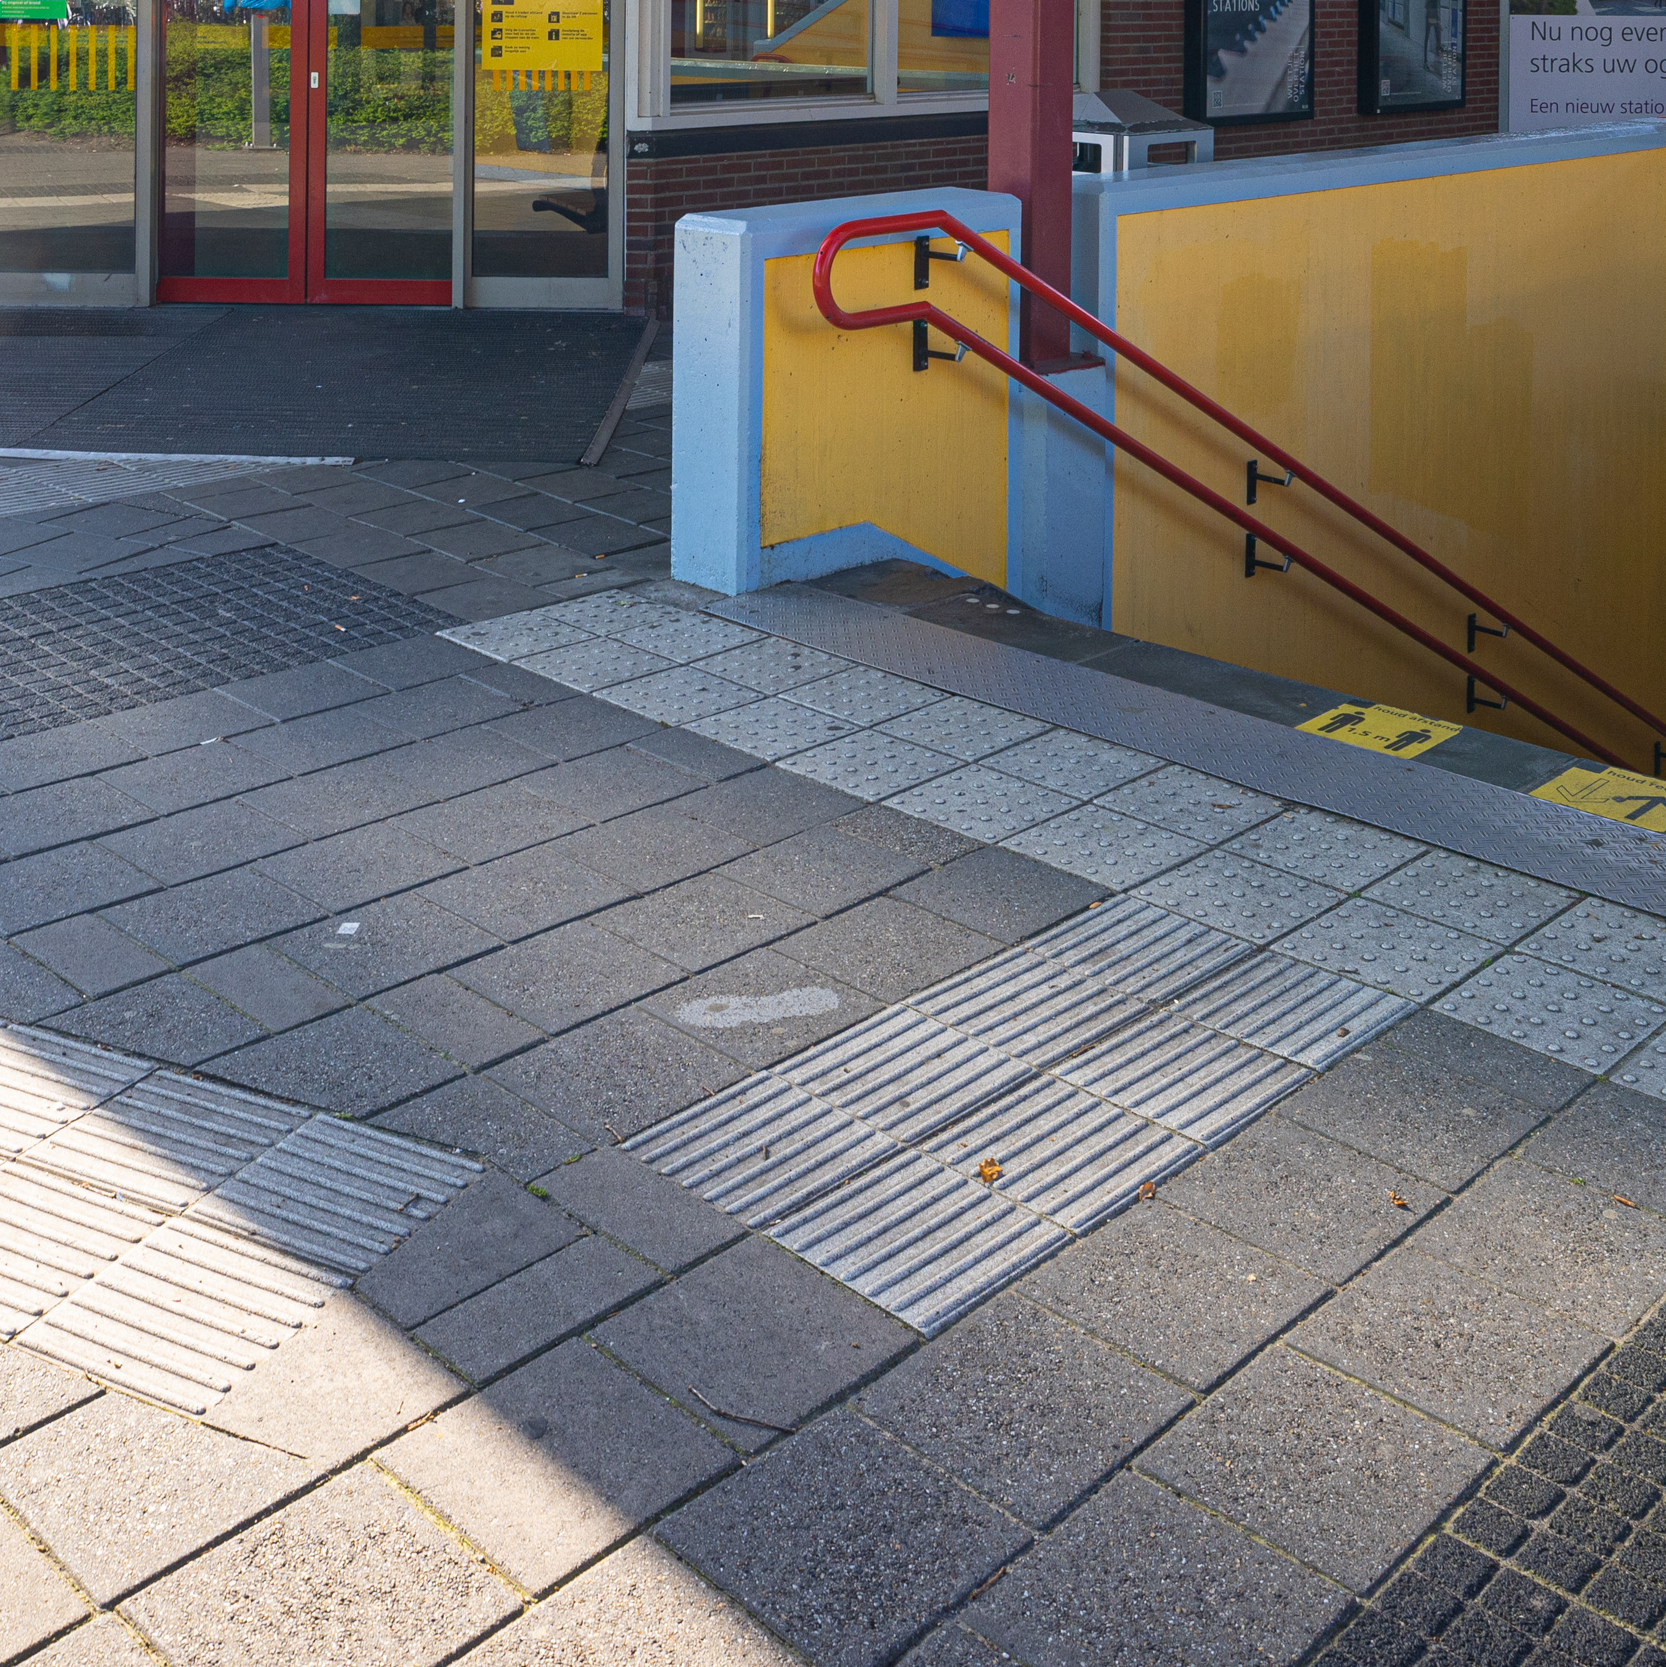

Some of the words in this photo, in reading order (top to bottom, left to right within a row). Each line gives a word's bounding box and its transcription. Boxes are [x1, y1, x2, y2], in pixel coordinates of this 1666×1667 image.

[1530, 20, 1562, 42] Nu
[1570, 25, 1613, 48] nog
[1529, 52, 1595, 74] straks
[1603, 57, 1638, 74] uw
[1530, 98, 1559, 115] Een
[1565, 99, 1615, 115] nieuw
[1374, 706, 1408, 718] houd
[1373, 735, 1391, 743] m
